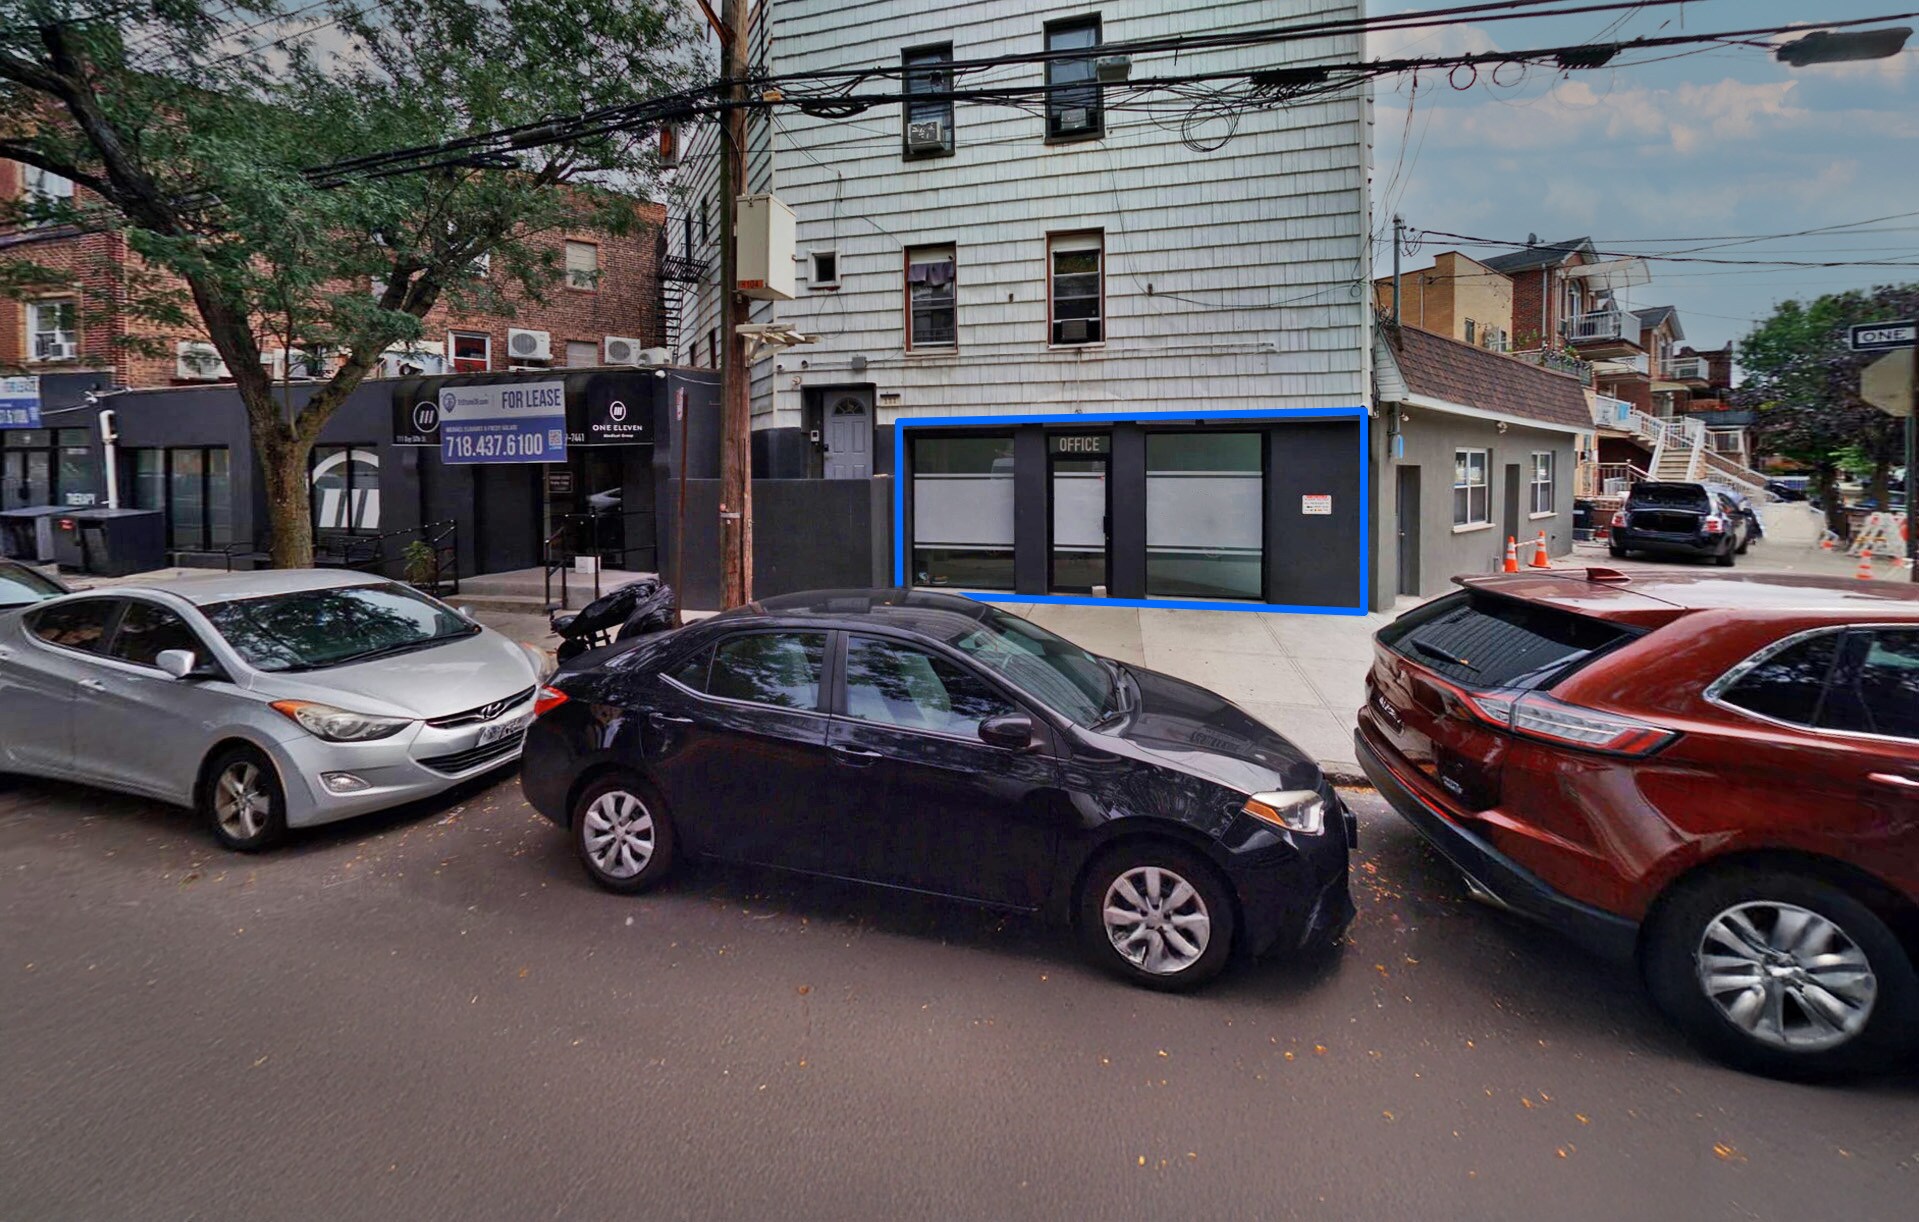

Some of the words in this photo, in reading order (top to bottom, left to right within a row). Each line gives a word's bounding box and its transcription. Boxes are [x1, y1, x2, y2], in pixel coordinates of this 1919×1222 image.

[1862, 329, 1907, 342] ONE
[502, 391, 523, 409] FOR
[526, 389, 561, 407] LEASE
[446, 433, 543, 457] 718.437.6100
[1059, 437, 1100, 452] OFFICE
